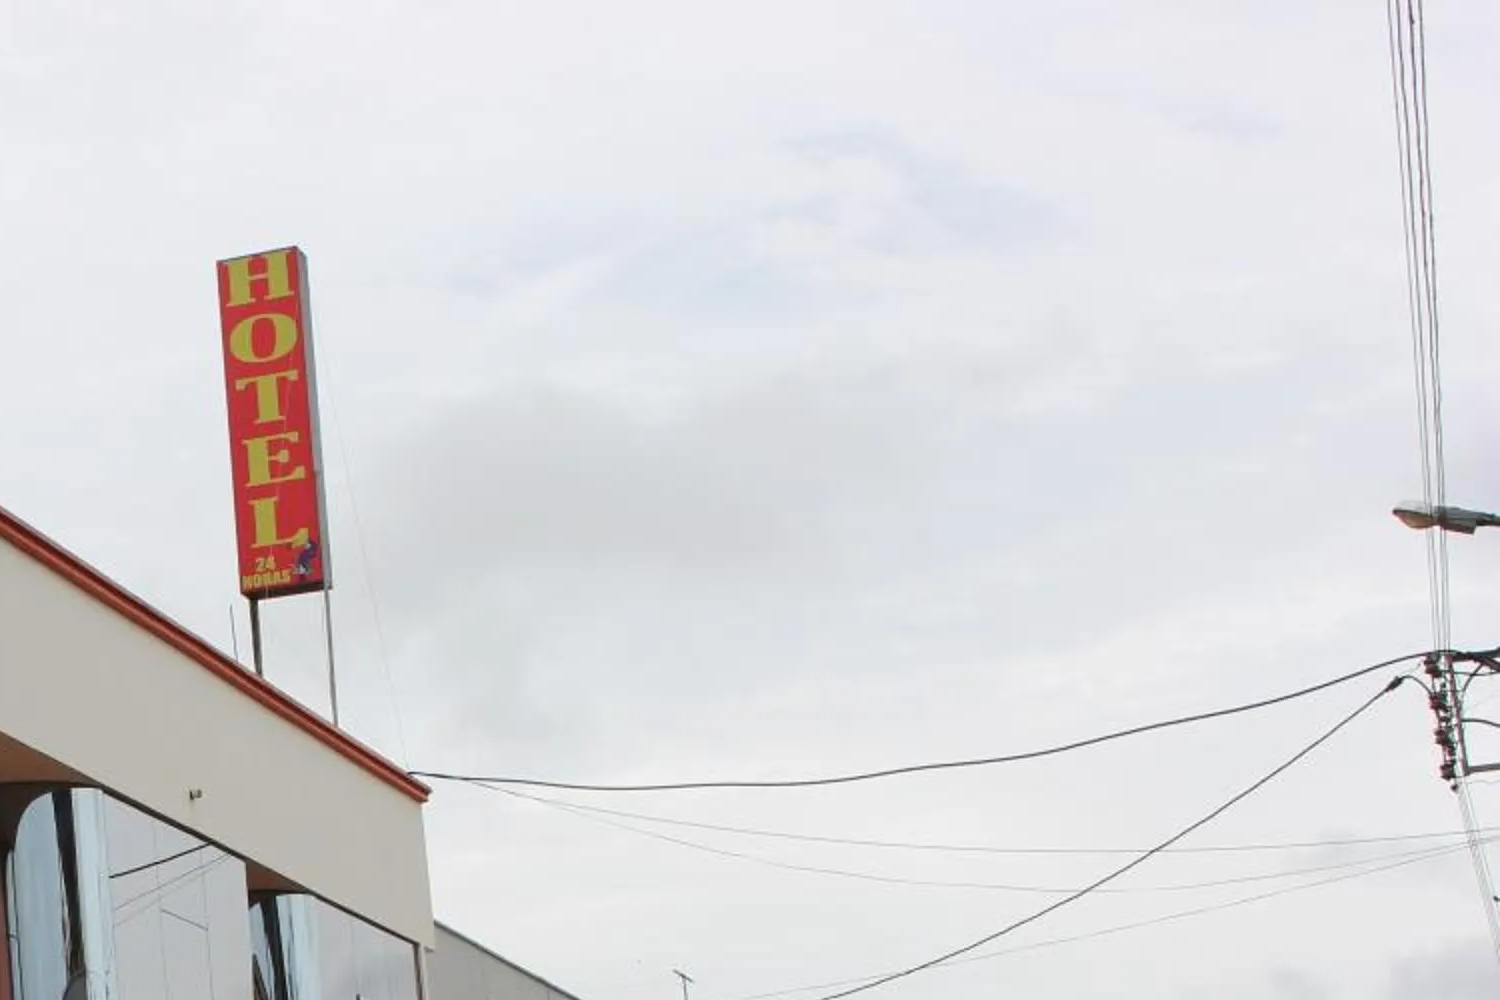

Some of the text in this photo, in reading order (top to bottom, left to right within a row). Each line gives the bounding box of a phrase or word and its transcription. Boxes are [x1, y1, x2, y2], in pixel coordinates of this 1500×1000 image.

[226, 250, 309, 549] HOTEL
[255, 556, 276, 572] 24
[242, 569, 292, 590] HORAS
